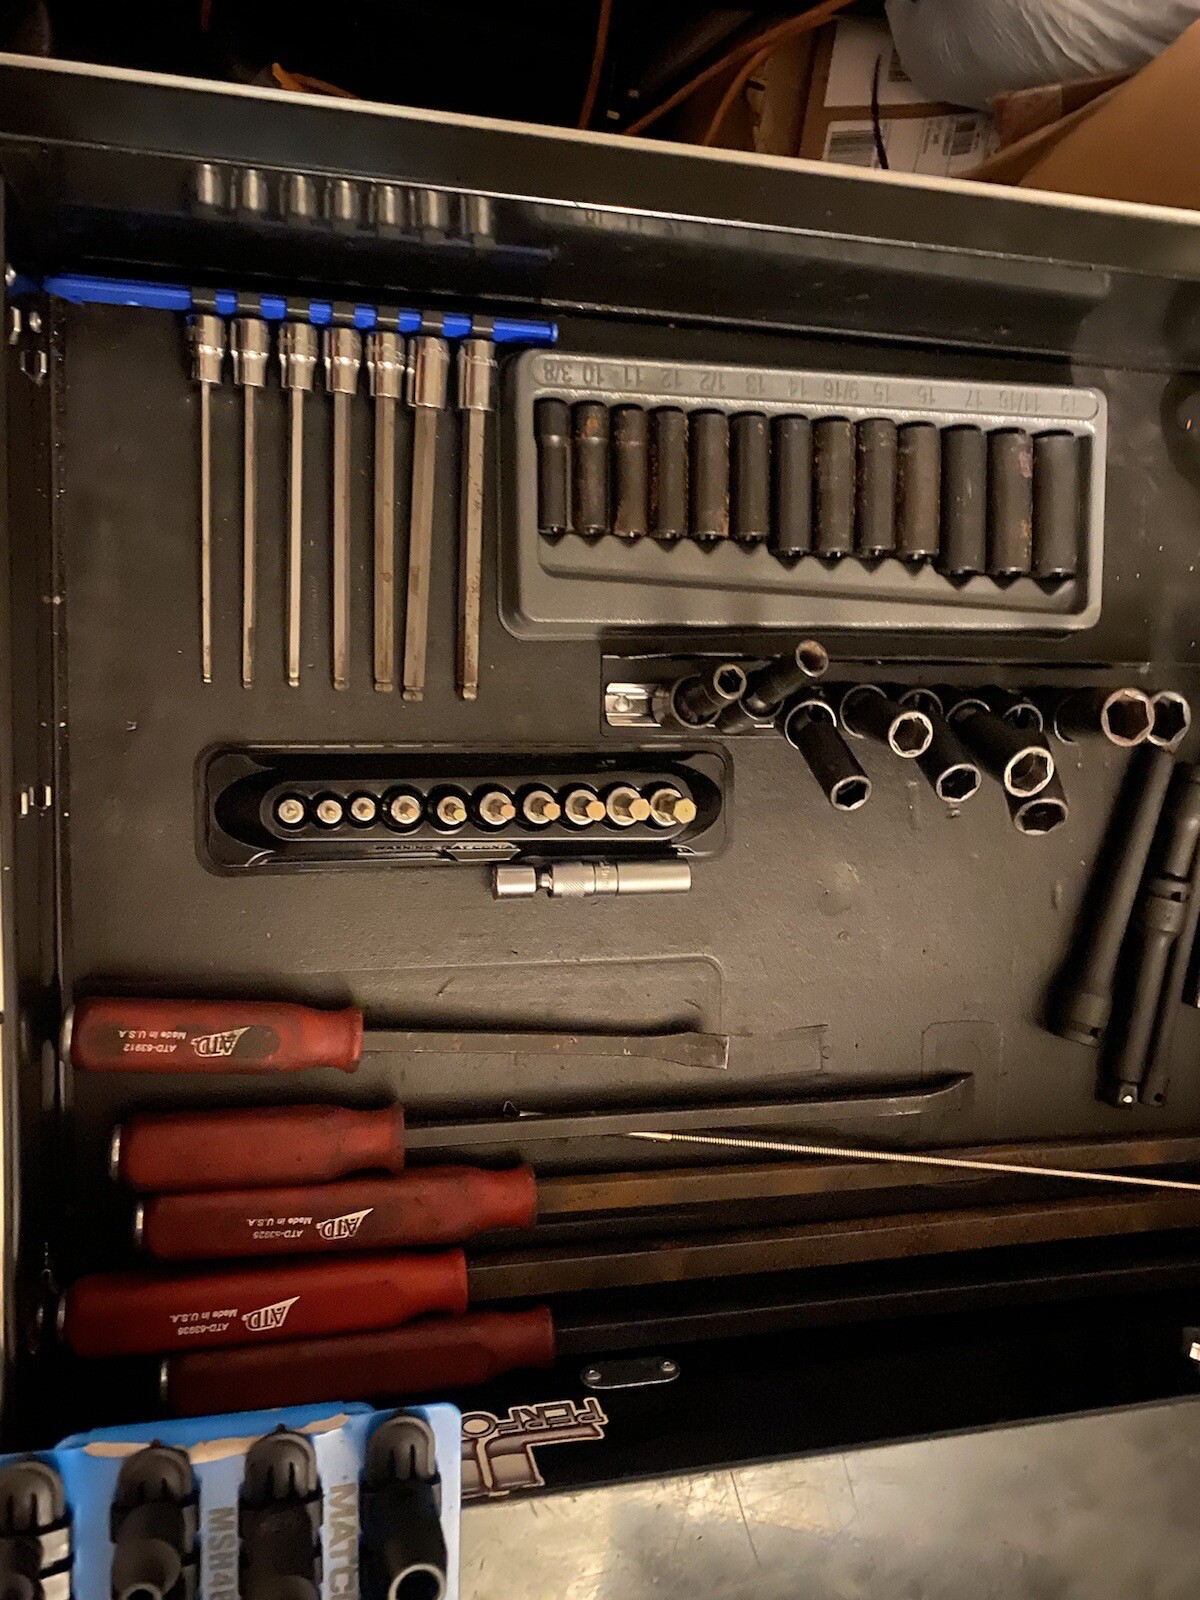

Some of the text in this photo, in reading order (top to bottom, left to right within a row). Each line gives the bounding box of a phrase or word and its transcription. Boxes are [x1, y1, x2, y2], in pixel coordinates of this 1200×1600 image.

[542, 361, 573, 384] 3/8
[582, 363, 604, 386] 10
[622, 365, 644, 388] 11
[660, 367, 683, 390] 12
[699, 369, 727, 393] 1/2
[787, 375, 807, 398] 14
[822, 378, 860, 401] 9/16
[964, 387, 983, 408] 17
[148, 1030, 159, 1039] in
[160, 1030, 187, 1040] Made
[194, 1031, 240, 1057] ATD
[276, 1217, 286, 1226] in
[287, 1216, 313, 1226] Made
[319, 1215, 364, 1240] ATD
[200, 1311, 211, 1320] in
[211, 1308, 239, 1319] Made
[244, 1303, 291, 1331] ATD
